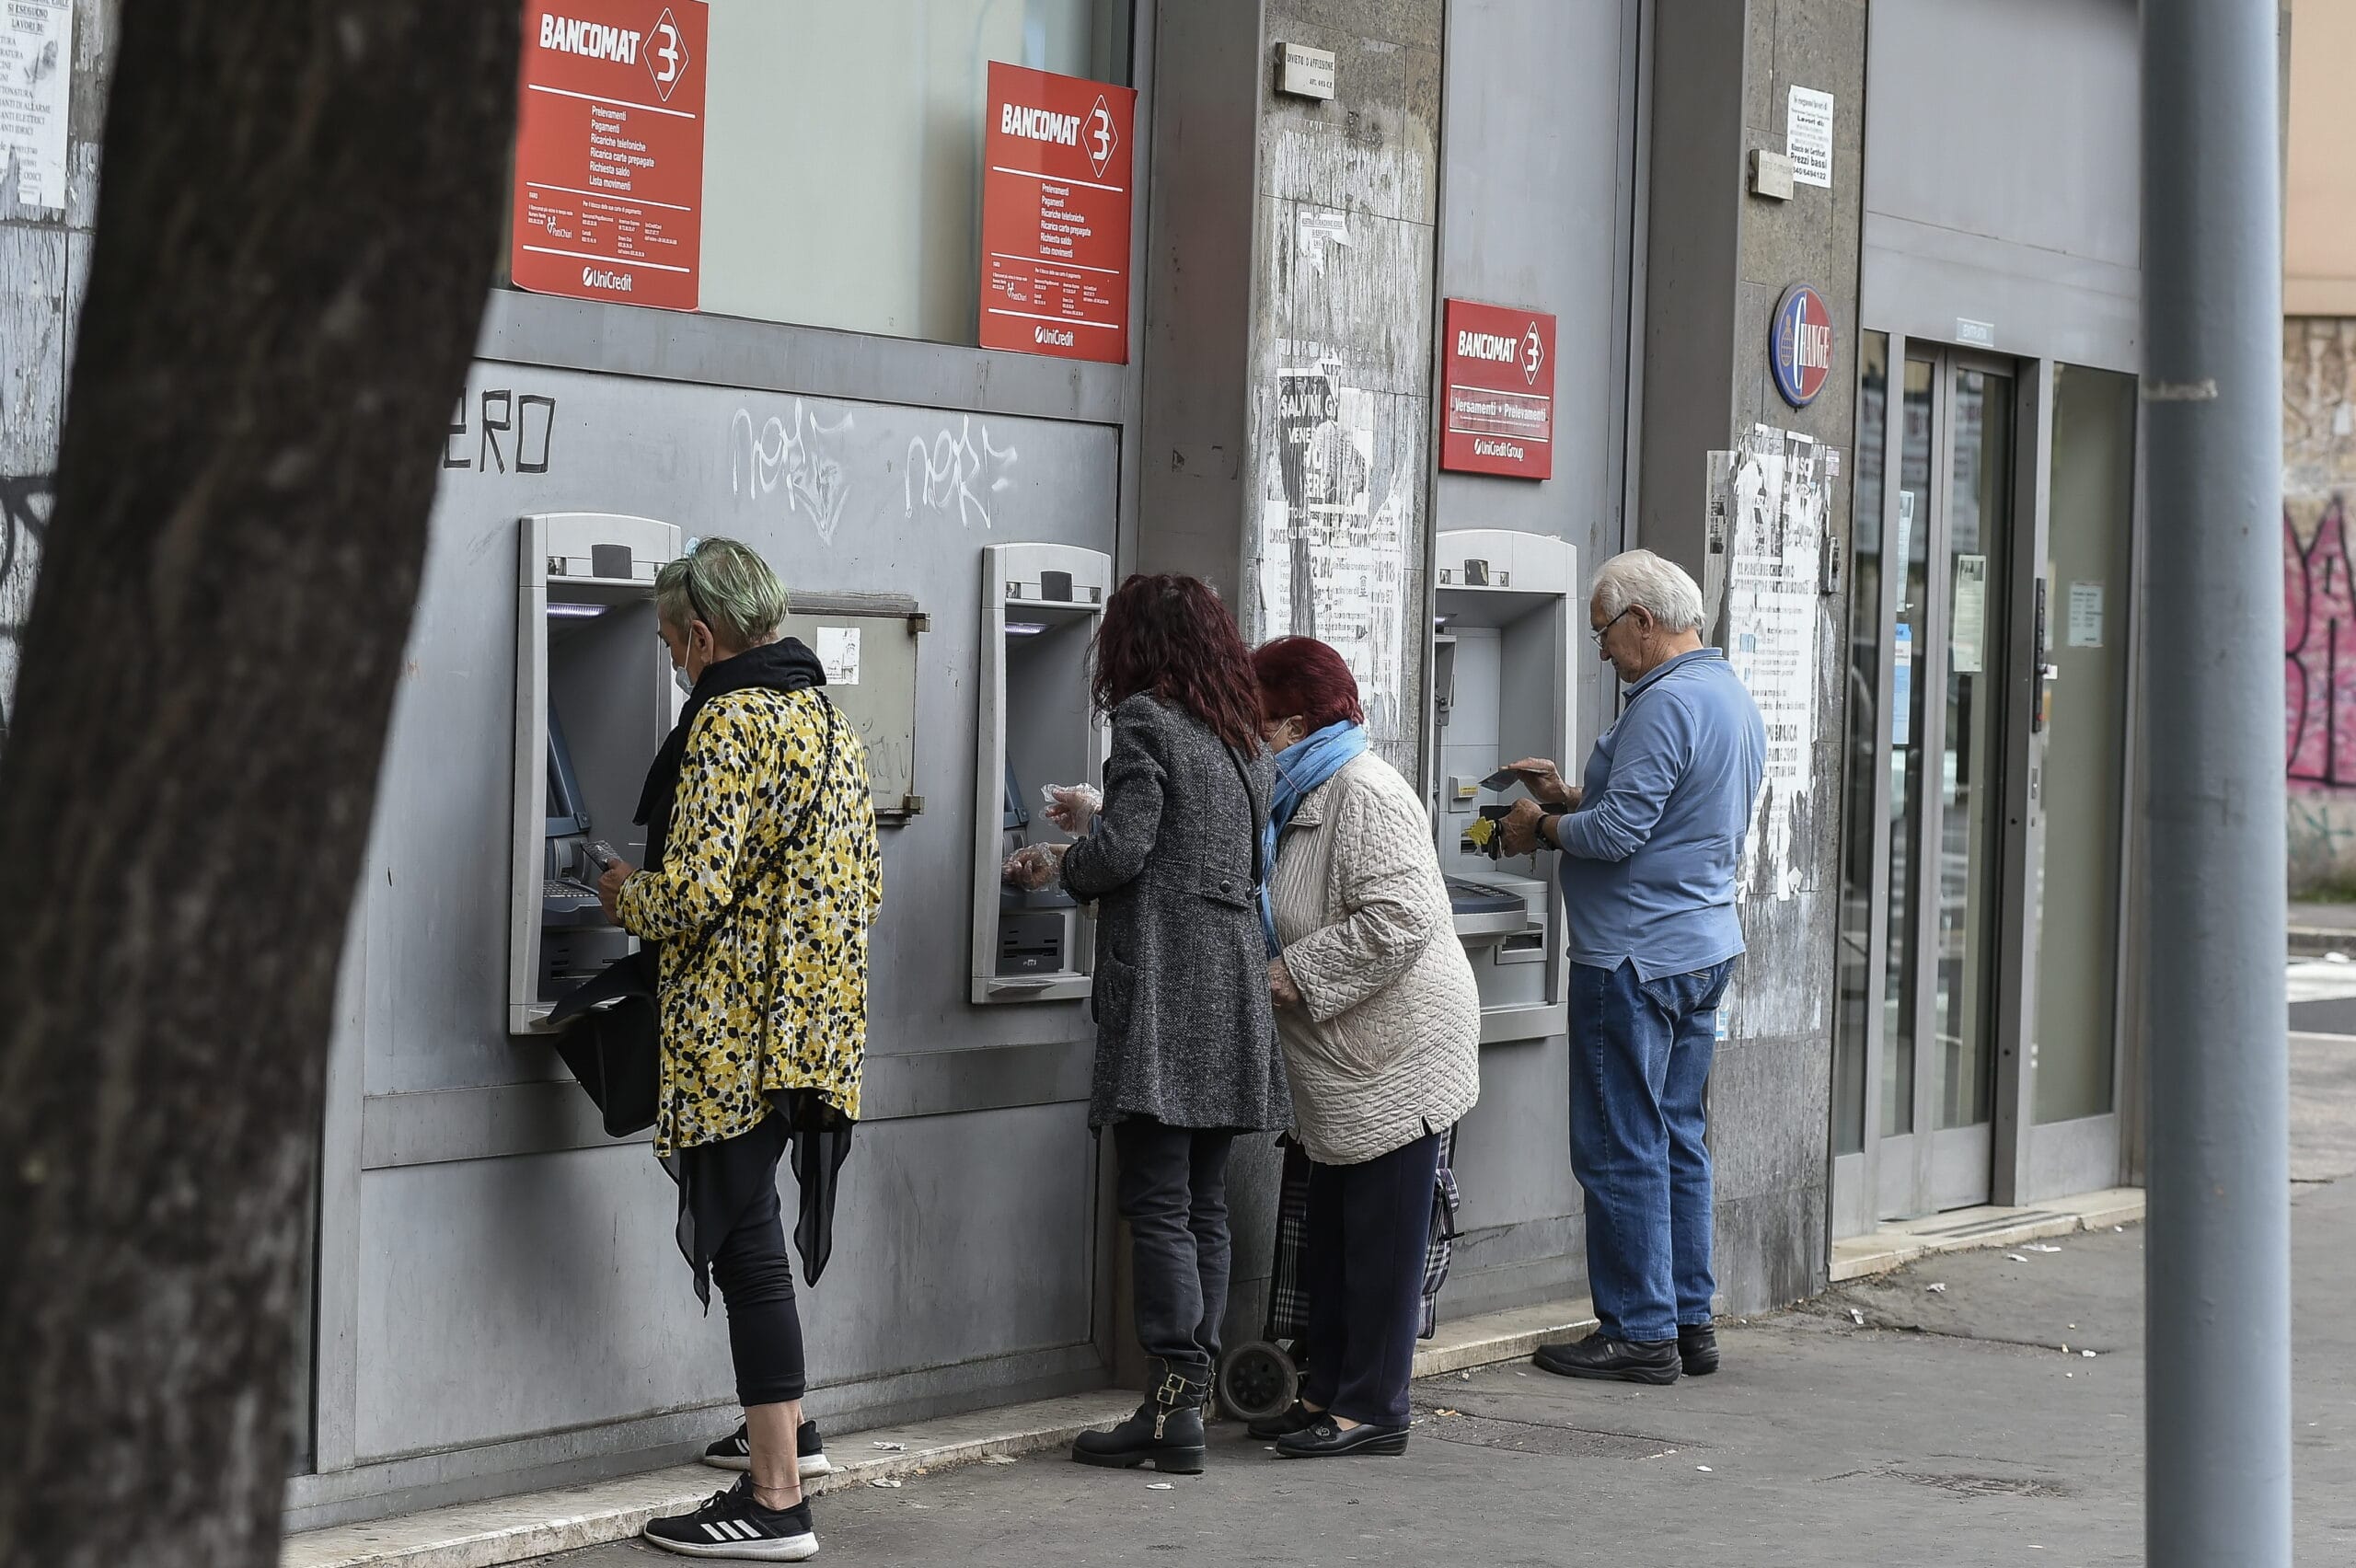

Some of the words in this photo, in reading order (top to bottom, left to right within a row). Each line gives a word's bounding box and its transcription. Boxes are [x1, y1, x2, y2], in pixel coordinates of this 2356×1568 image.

[12, 19, 35, 31] LAVORI
[539, 13, 641, 65] BANCOMAT
[592, 105, 627, 121] Prelevamenti
[591, 119, 620, 133] Pagamenti
[1001, 103, 1080, 146] BANCOMAT
[591, 133, 617, 147] Ricariche
[617, 138, 646, 152] telefoniche
[590, 146, 612, 160] Ricarica
[613, 153, 627, 162] carte
[628, 156, 655, 168] prepagate
[590, 161, 615, 174] Richiesta
[615, 167, 630, 178] saldo
[589, 175, 603, 186] Lista
[604, 179, 631, 190] movimenti
[594, 270, 632, 292] UniCredit
[1043, 328, 1074, 347] UniCredit
[1458, 330, 1517, 363] BANCOMAT
[1794, 296, 1830, 390] CHANGE
[1455, 397, 1496, 416] Versamenti
[1504, 403, 1546, 422] Prelevamenti
[1481, 441, 1507, 457] UniCredit
[1507, 443, 1524, 462] Group
